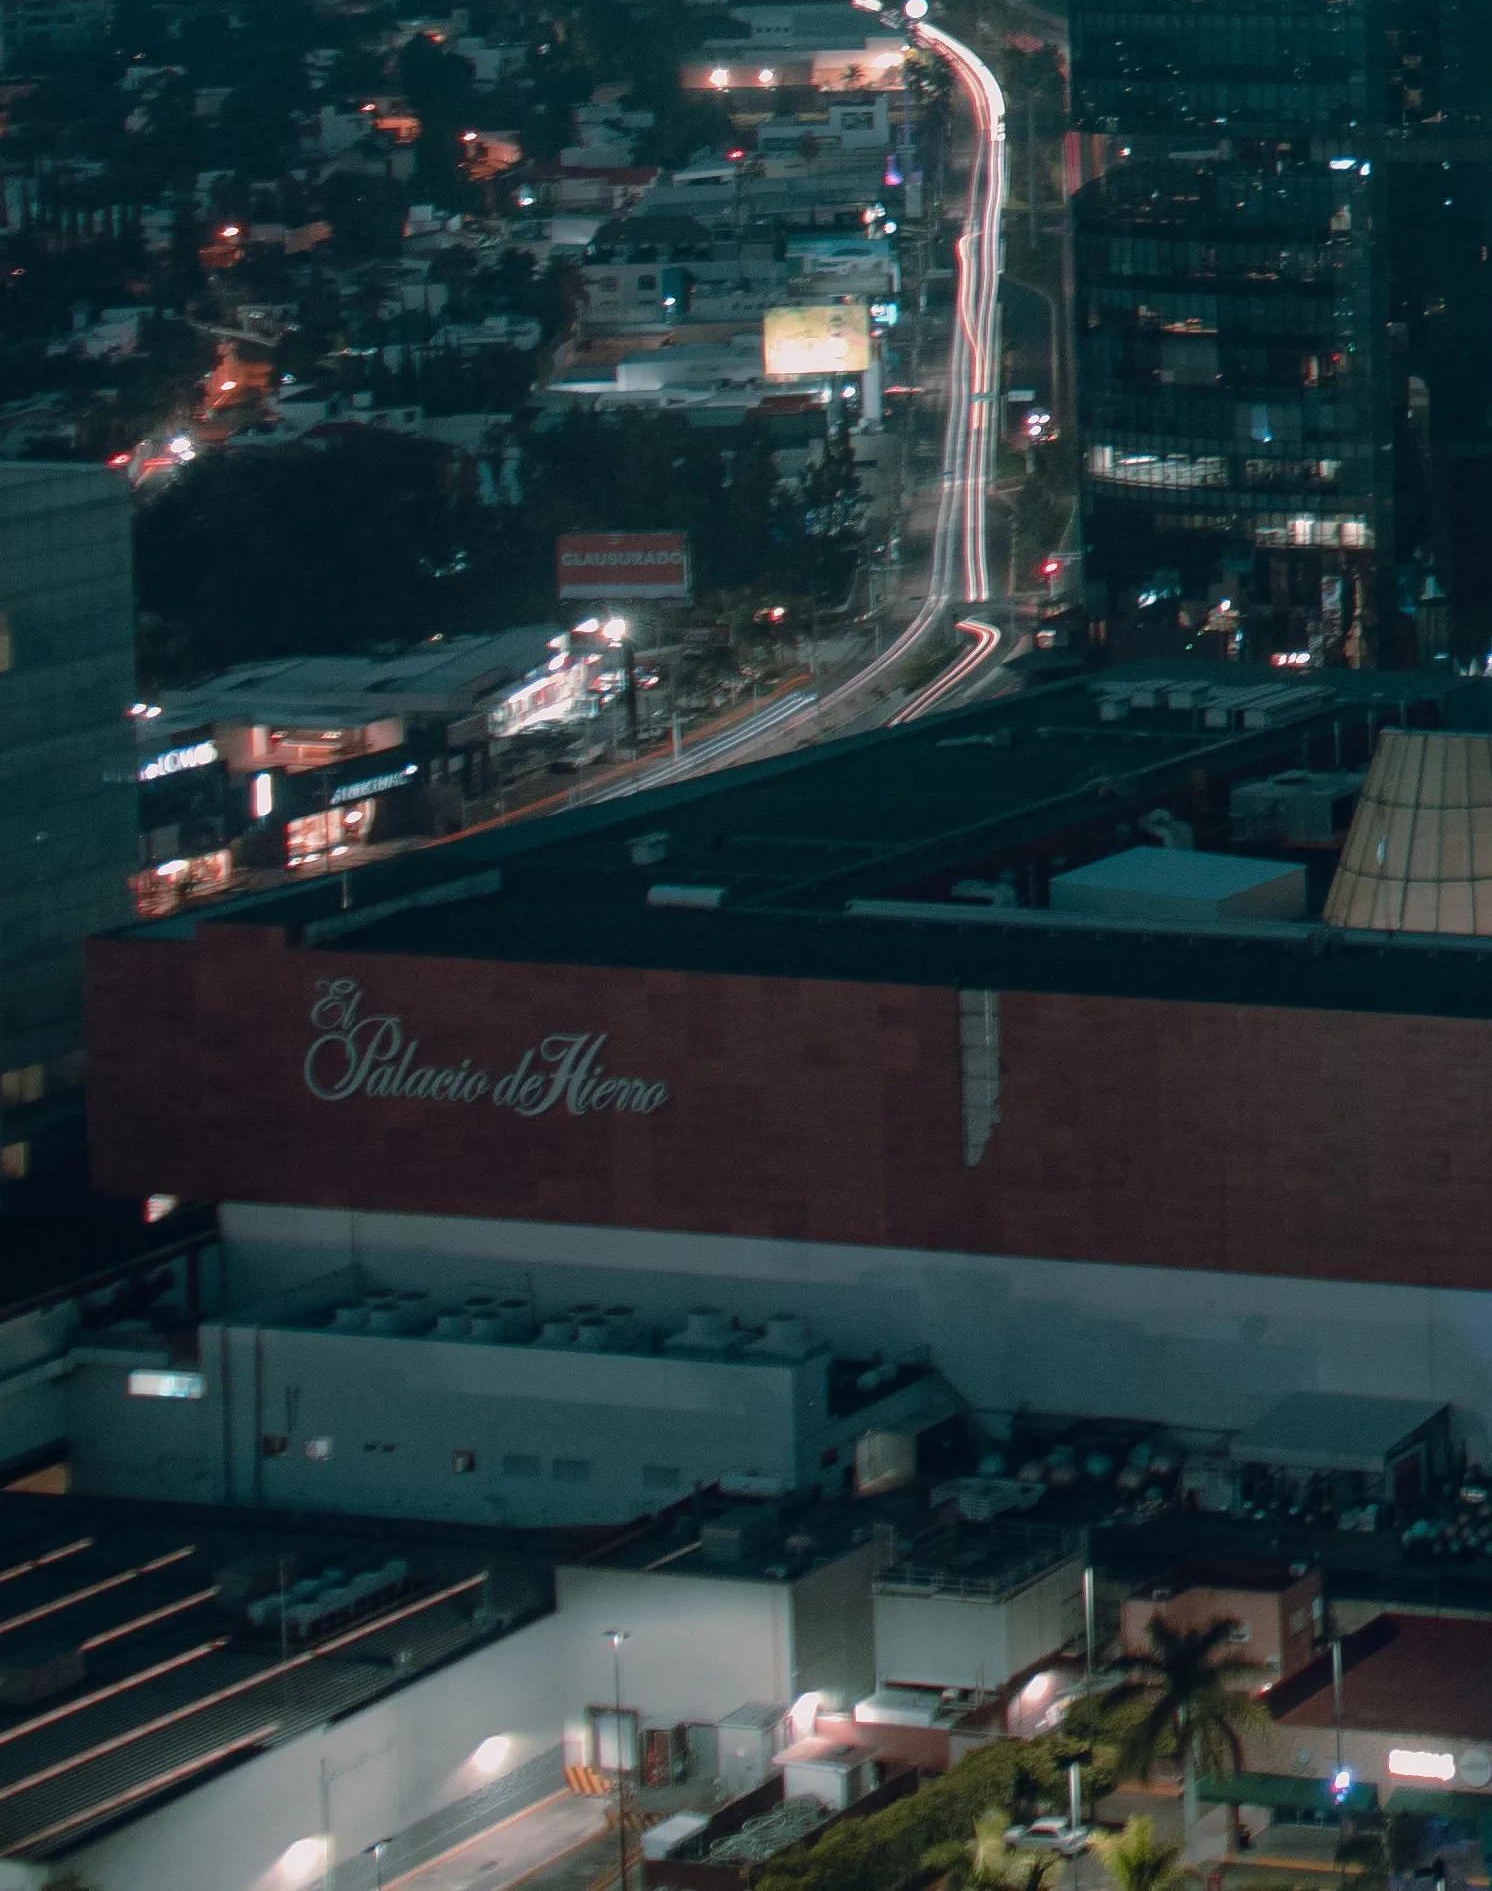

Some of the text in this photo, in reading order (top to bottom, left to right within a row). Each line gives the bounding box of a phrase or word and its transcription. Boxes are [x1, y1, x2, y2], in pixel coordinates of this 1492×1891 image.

[561, 550, 684, 566] CLAUSURADO
[310, 976, 364, 1030] El
[303, 1014, 668, 1117] Palacio de Hierro
